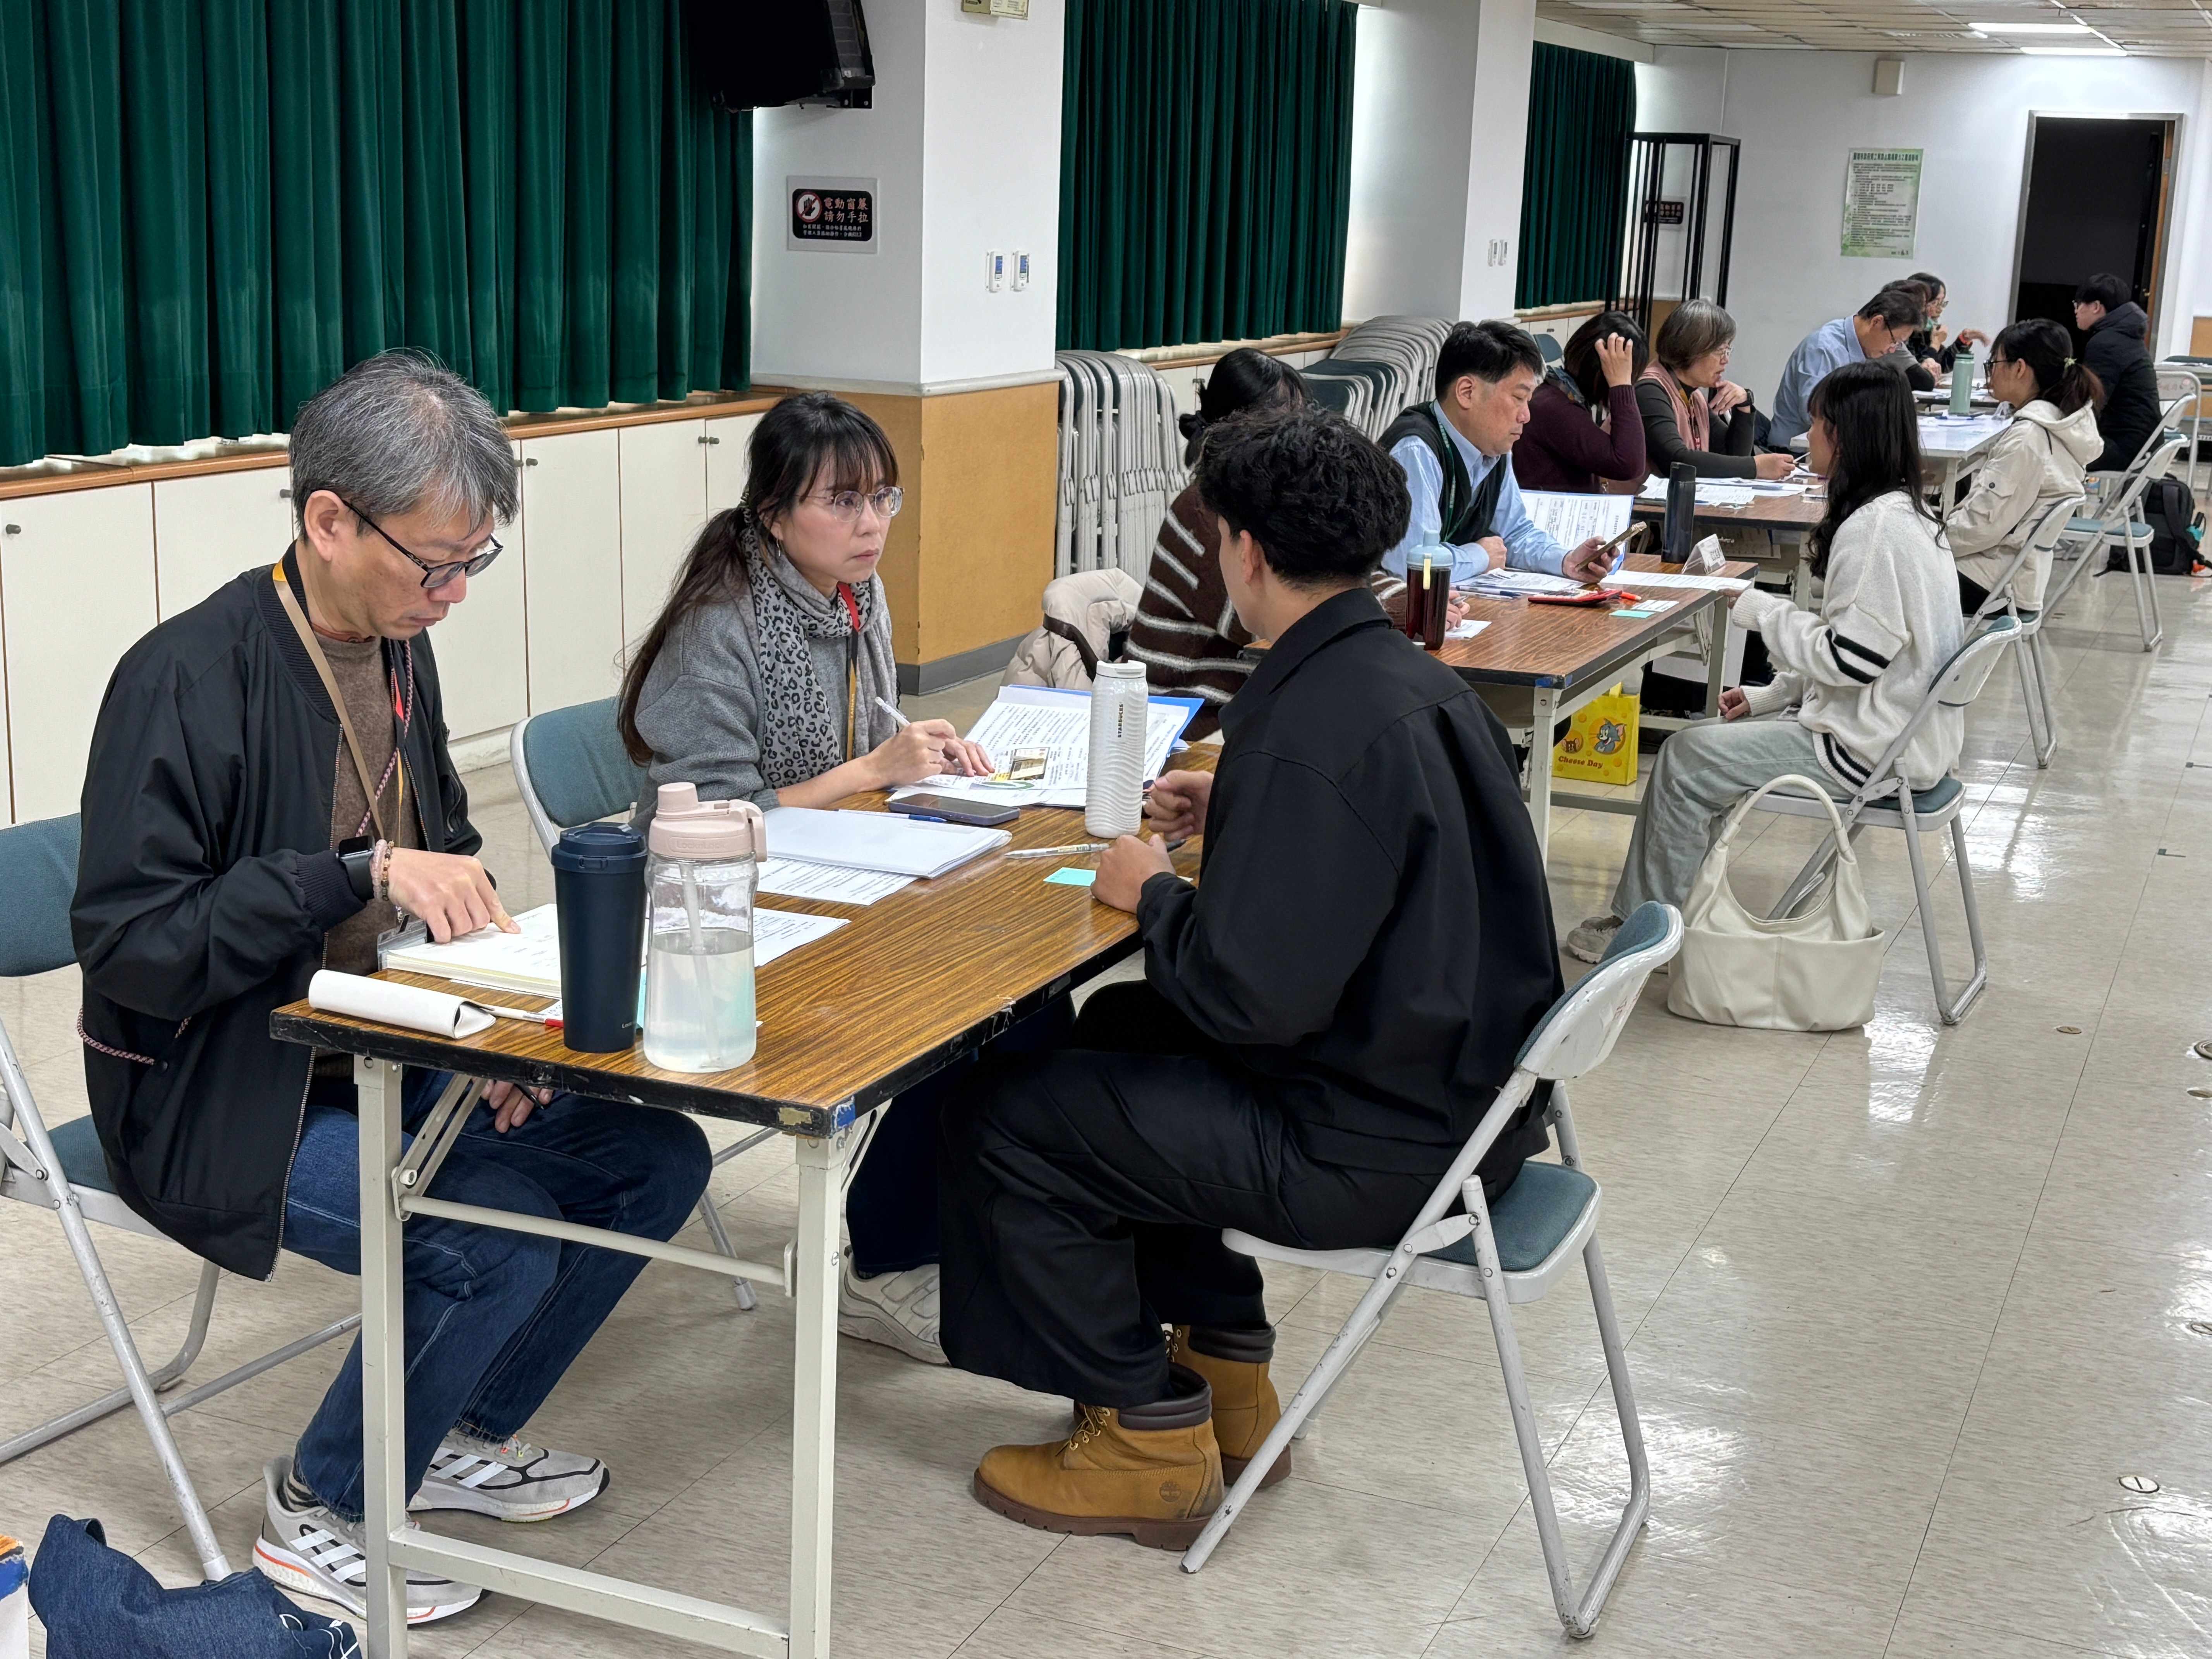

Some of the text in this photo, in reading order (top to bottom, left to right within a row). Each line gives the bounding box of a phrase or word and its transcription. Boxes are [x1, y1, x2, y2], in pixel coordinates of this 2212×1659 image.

[824, 210, 869, 223] 請勿手拉
[1558, 756, 1603, 769] Cheese Day
